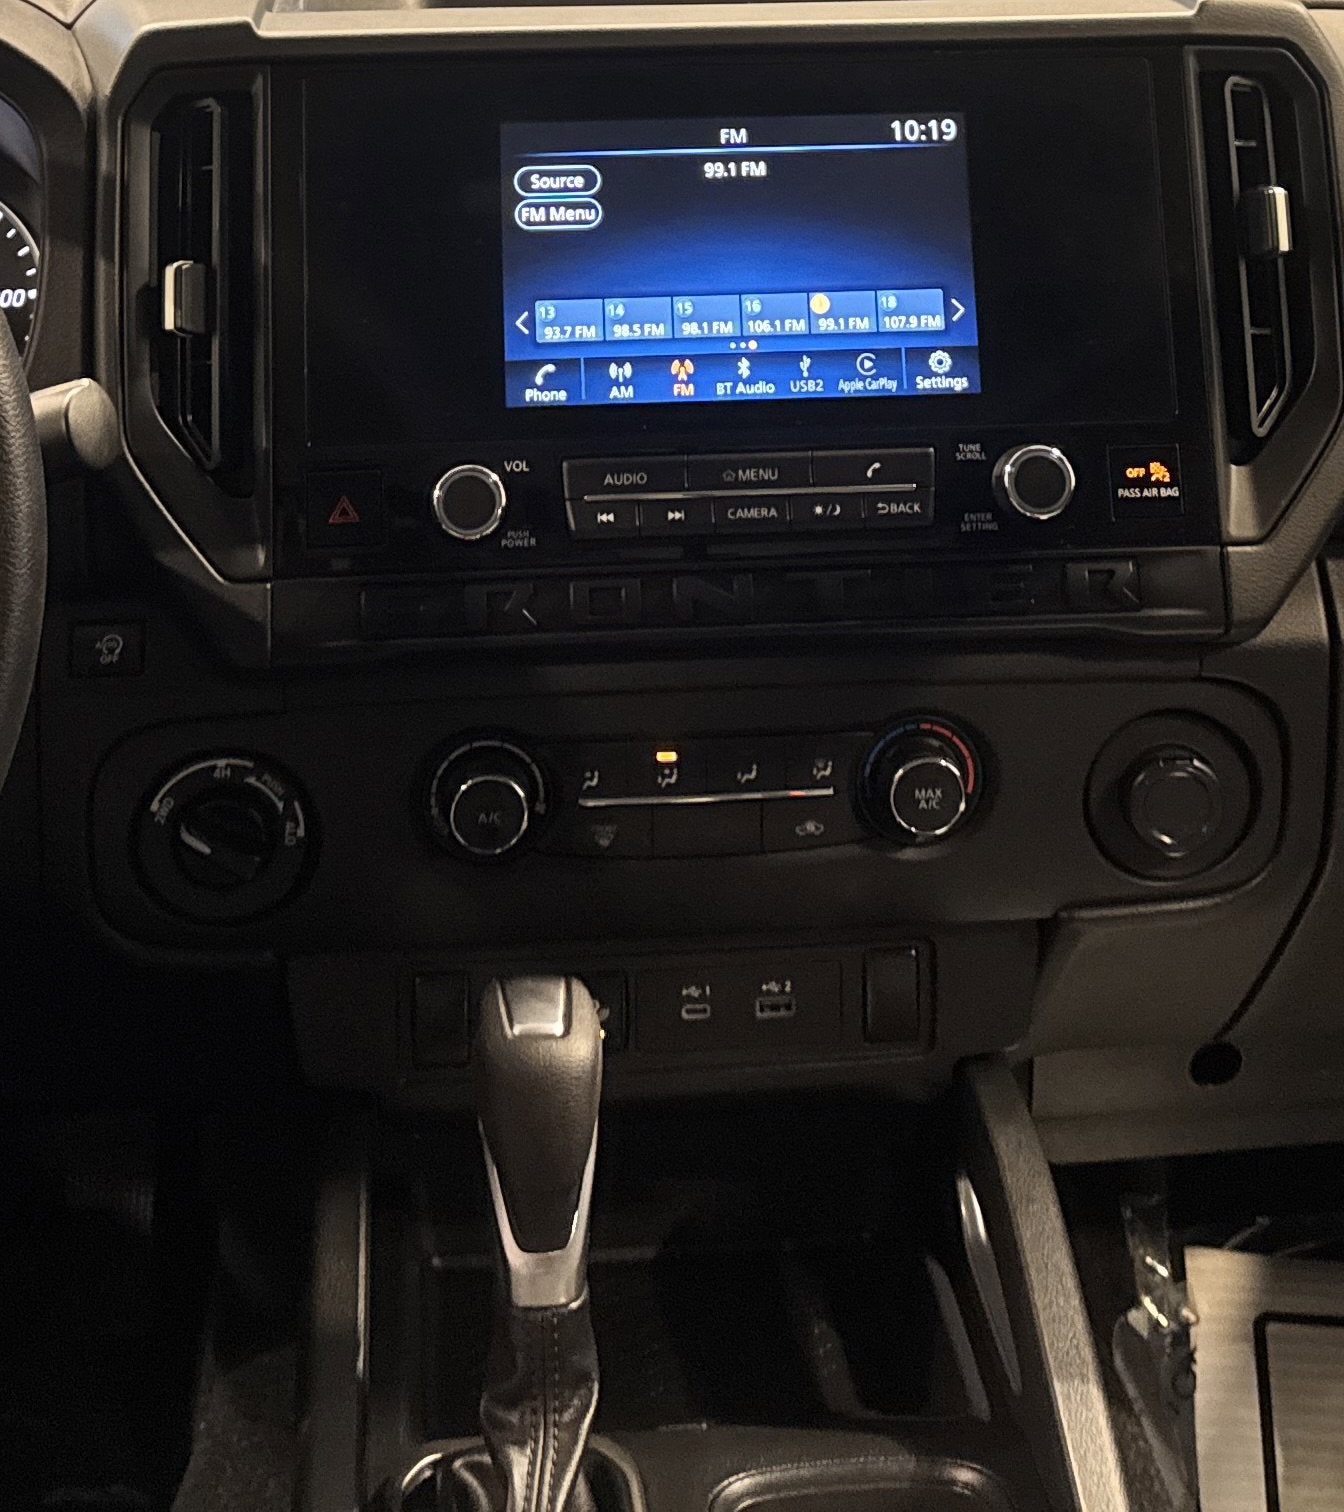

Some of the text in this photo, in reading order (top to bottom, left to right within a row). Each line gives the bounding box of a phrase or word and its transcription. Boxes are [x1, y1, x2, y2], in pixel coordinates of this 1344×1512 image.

[719, 128, 747, 144] FM
[889, 118, 958, 142] 10:19
[703, 161, 767, 178] 99.1 FM
[530, 173, 585, 188] Source
[521, 205, 595, 223] FM Menu
[681, 321, 733, 335] 98.1 FM
[748, 319, 805, 332] 106.1 FM
[818, 317, 869, 330] 99.1 FM
[884, 315, 941, 329] 107.9 FM
[544, 326, 596, 339] 93.7 FM
[613, 323, 665, 336] 98.5 FM
[673, 383, 695, 396] FM
[716, 381, 775, 395] BT Audio
[790, 379, 824, 392] USB2
[838, 377, 898, 392] Apple CarPlay
[915, 376, 969, 392] Settings
[525, 388, 567, 402] Phone
[609, 386, 634, 399] AM
[958, 443, 982, 452] TUNE
[955, 452, 987, 461] SCROLL
[504, 460, 530, 473] VOL
[1126, 467, 1146, 479] OFF
[603, 472, 647, 485] AUDIO
[738, 468, 778, 481] MENU
[1118, 487, 1179, 498] PASS AIR BAG
[727, 506, 778, 519] CAMERA
[890, 502, 921, 514] BACK
[501, 538, 536, 547] POWER
[915, 789, 943, 799] MAX
[918, 799, 941, 810] A/C
[477, 812, 501, 825] A/C
